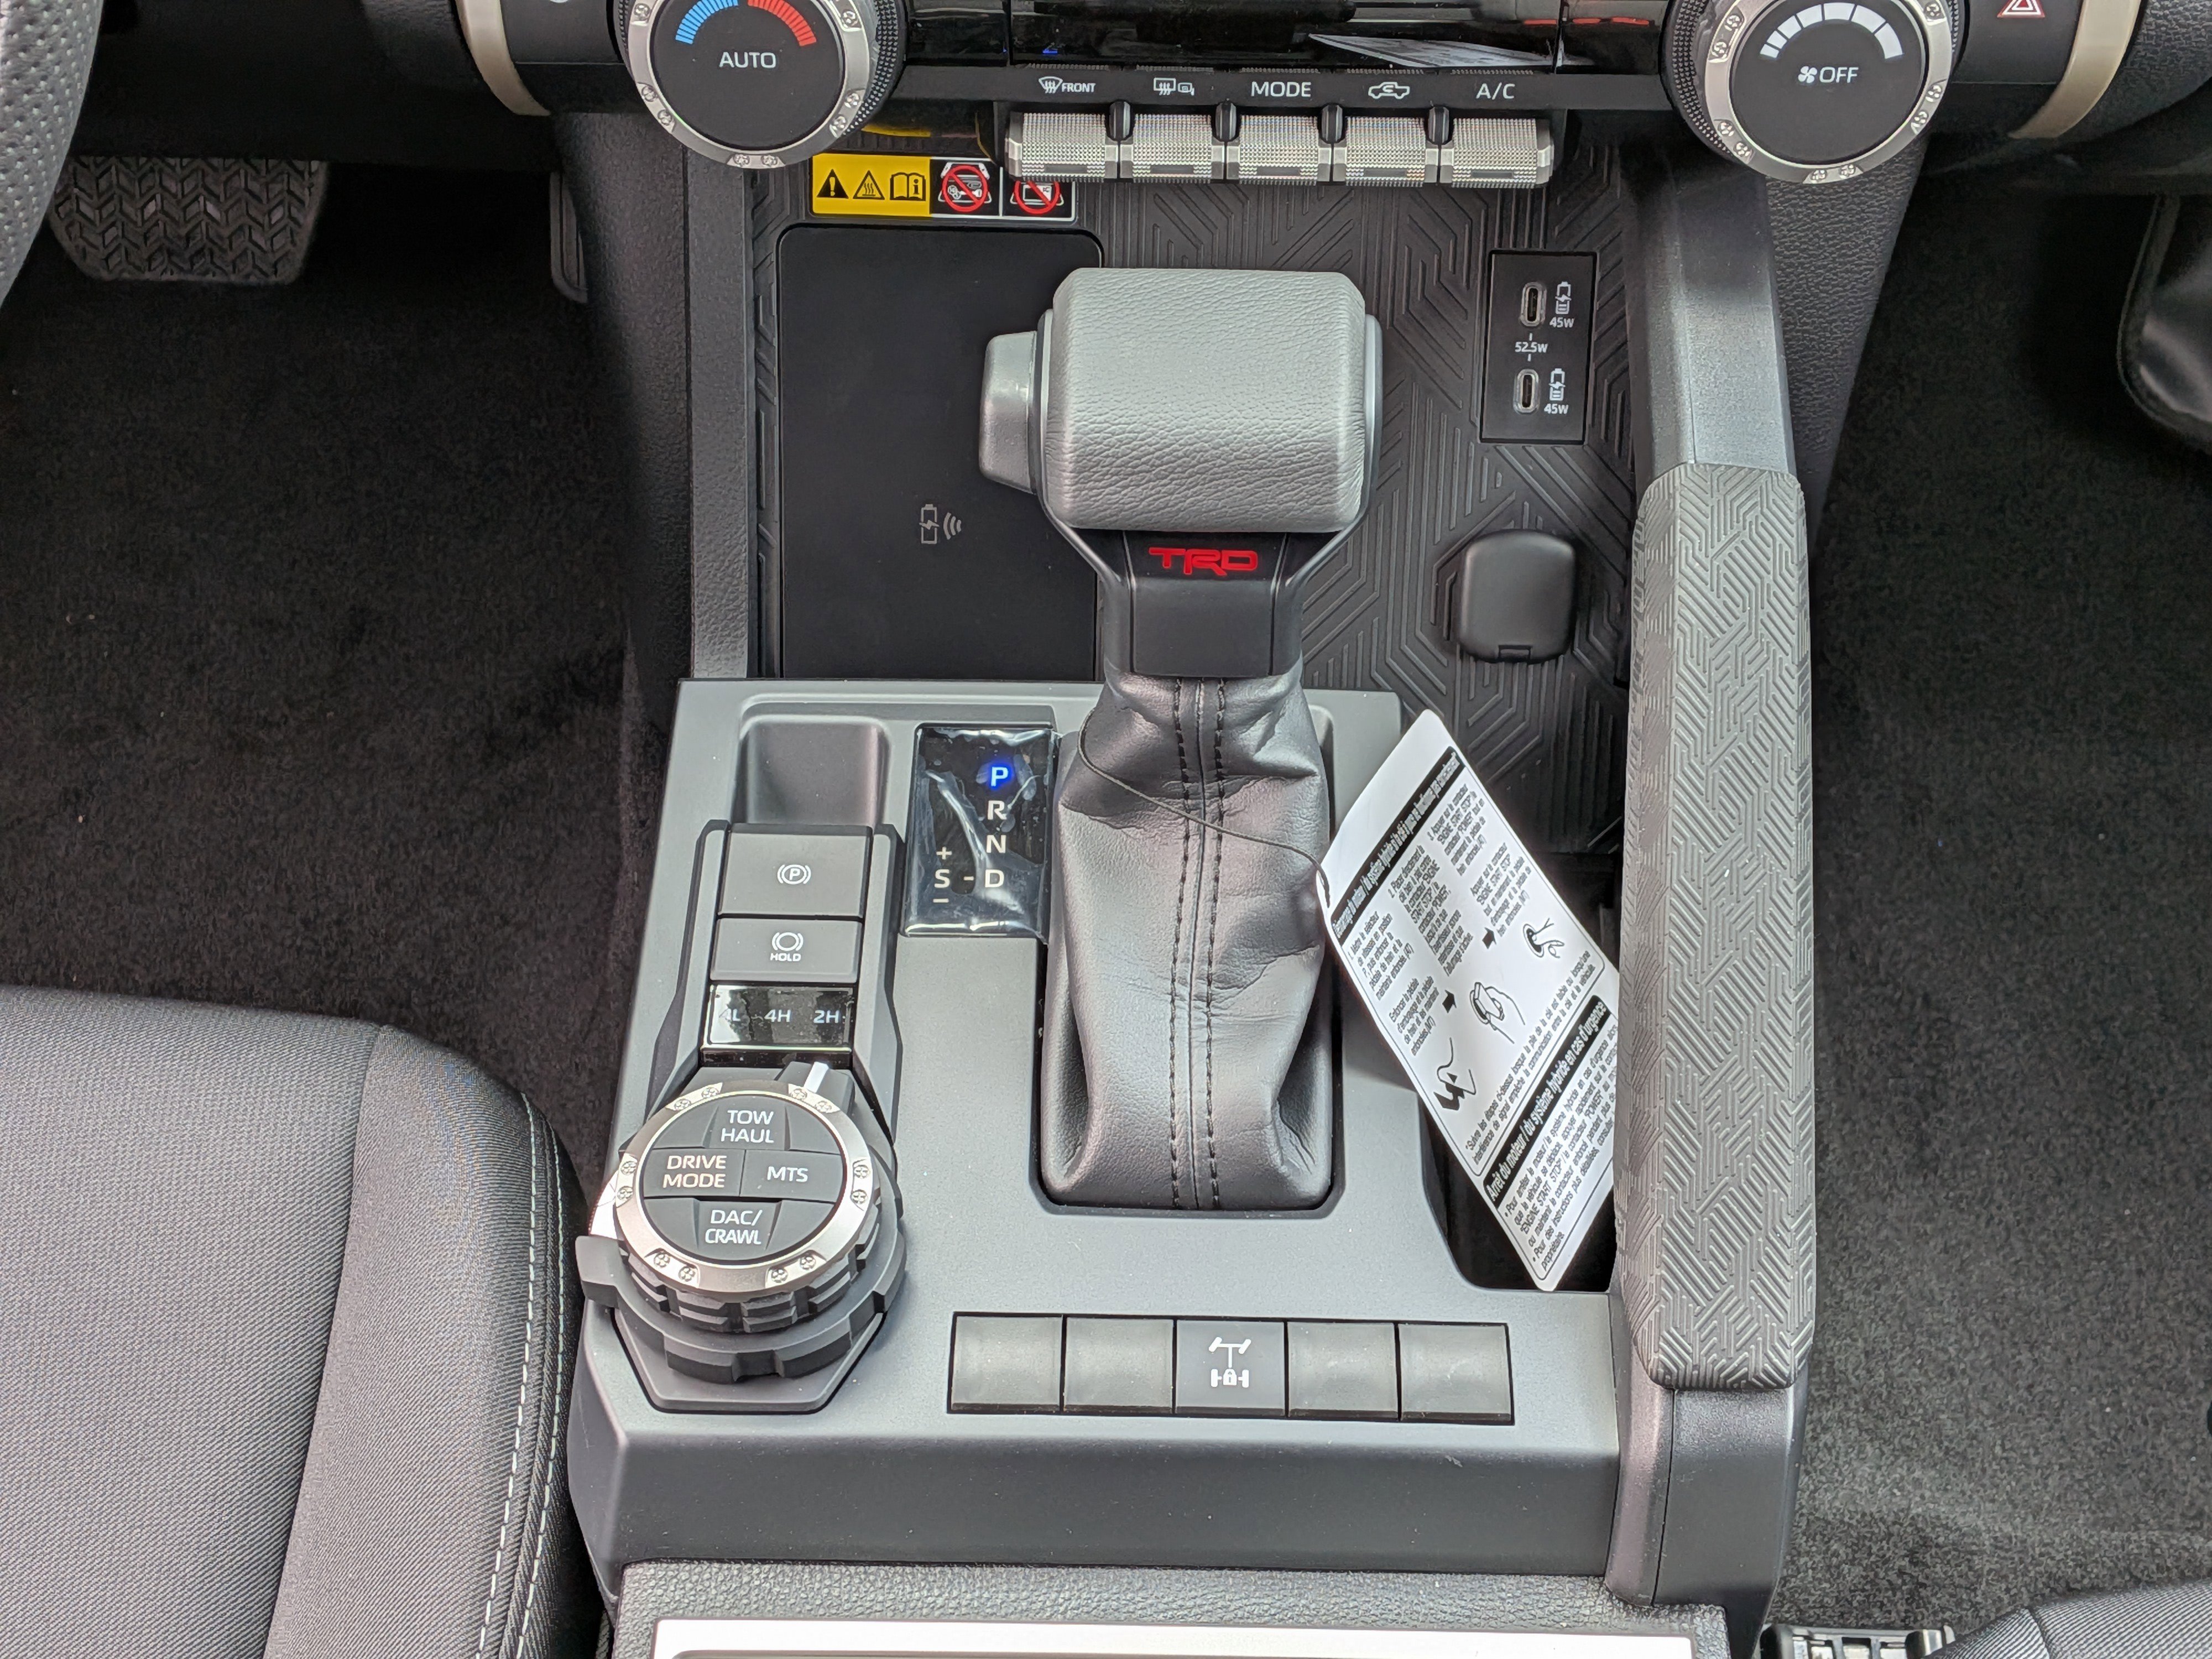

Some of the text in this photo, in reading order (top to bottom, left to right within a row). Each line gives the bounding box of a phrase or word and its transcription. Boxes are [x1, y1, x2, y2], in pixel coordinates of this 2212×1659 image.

[719, 51, 776, 69] AUTO
[1820, 67, 1859, 84] OFF
[1062, 82, 1096, 93] FRONT
[1251, 81, 1311, 98] MODE
[1476, 82, 1515, 100] A/C
[1549, 317, 1574, 328] 45W
[1544, 403, 1569, 415] 45W
[1149, 547, 1258, 576] TRD
[991, 766, 1009, 787] P
[987, 800, 1007, 820] R
[986, 834, 1006, 853] N
[934, 869, 950, 888] S
[985, 869, 1004, 888] D
[770, 953, 801, 962] HOLD
[764, 1009, 792, 1022] 4H
[813, 1010, 839, 1023] 2H
[1577, 995, 1609, 1047] d'urgence
[1570, 1034, 1585, 1057] cas
[1564, 1047, 1577, 1067] en
[1545, 1055, 1573, 1099] hybride
[1527, 1082, 1557, 1130] système
[727, 1109, 774, 1125] TOW
[1521, 1114, 1536, 1138] du
[721, 1128, 774, 1144] HAUL
[1504, 1129, 1528, 1170] moteur
[666, 1155, 727, 1170] DRIVE
[1497, 1157, 1512, 1182] du
[662, 1173, 725, 1188] MODE
[767, 1167, 808, 1183] MTS
[1484, 1168, 1505, 1202] Arrêt
[710, 1209, 763, 1225] DAC/
[705, 1229, 761, 1245] CRAWL
